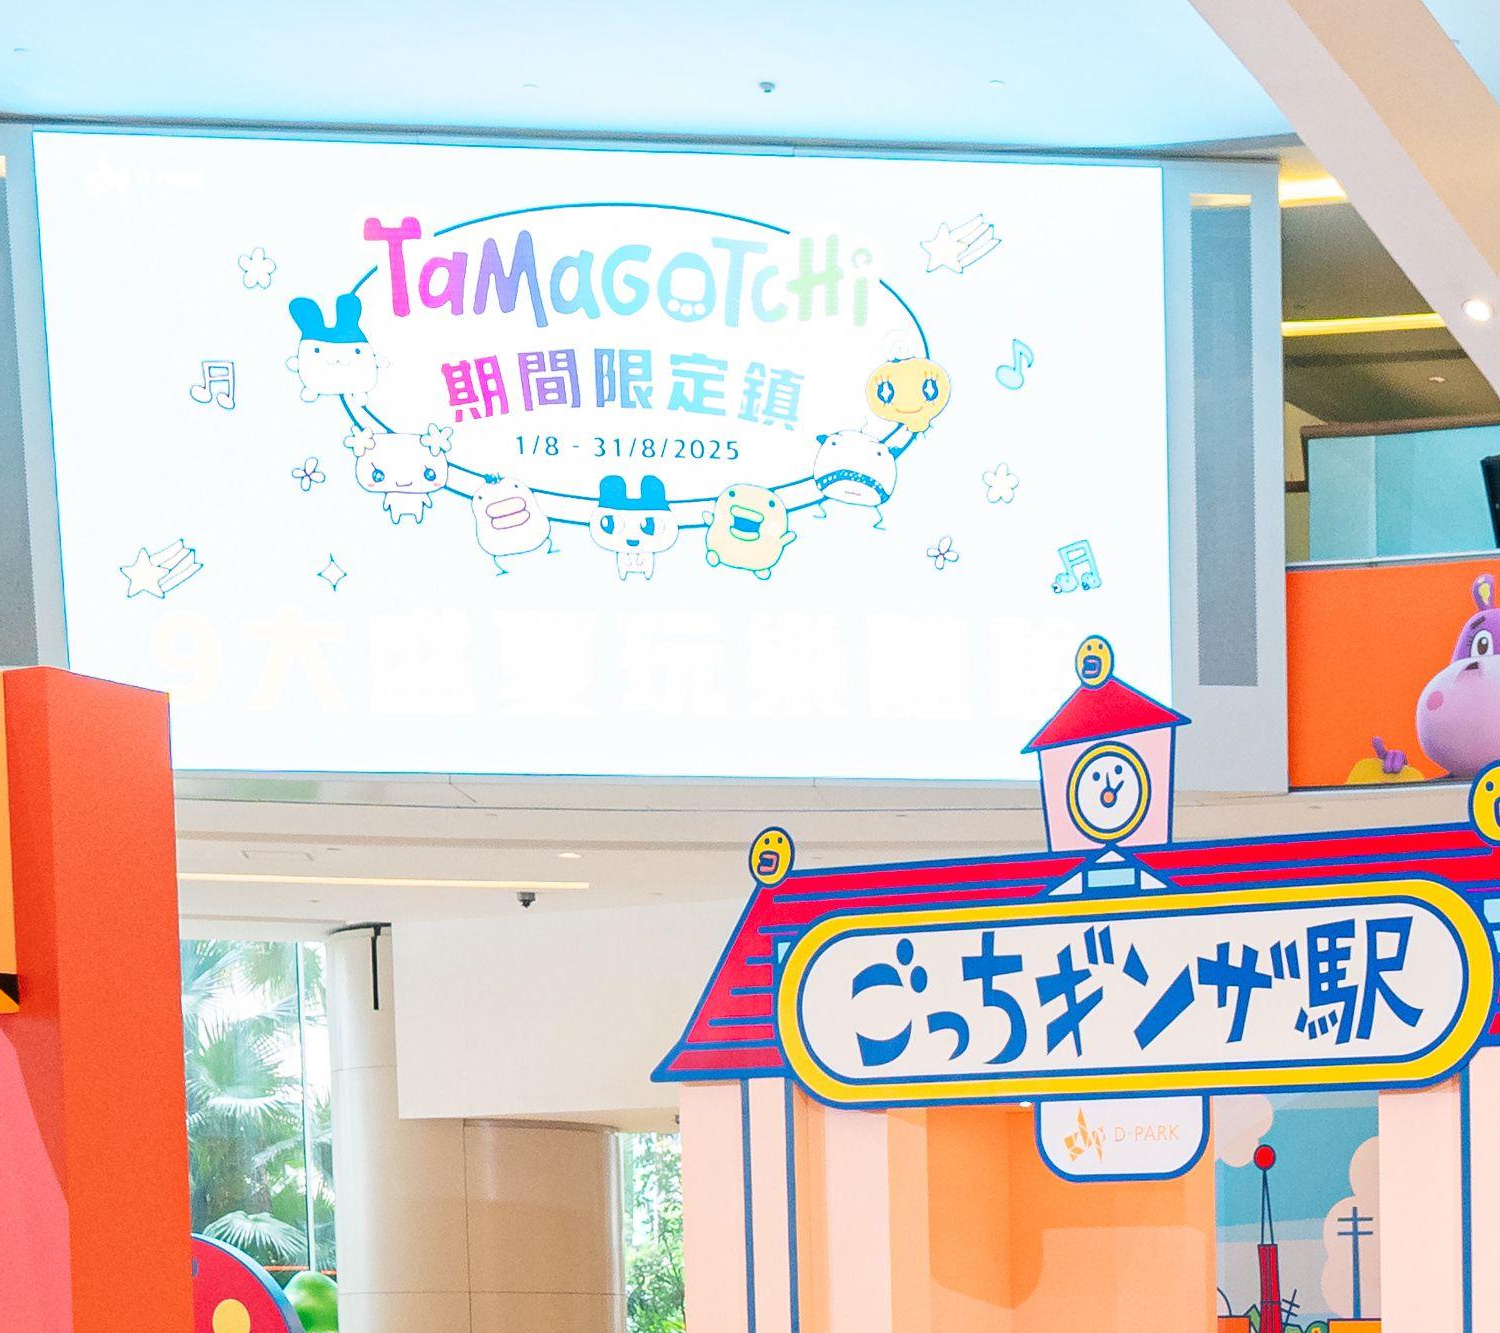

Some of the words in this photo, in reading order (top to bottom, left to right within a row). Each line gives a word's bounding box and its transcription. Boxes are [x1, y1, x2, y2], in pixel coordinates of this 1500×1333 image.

[440, 348, 805, 431] 期間限定鎮
[515, 435, 559, 456] 1/8
[594, 436, 740, 461] 31/8/2025
[851, 916, 1424, 1067] ごっちギンザ駅
